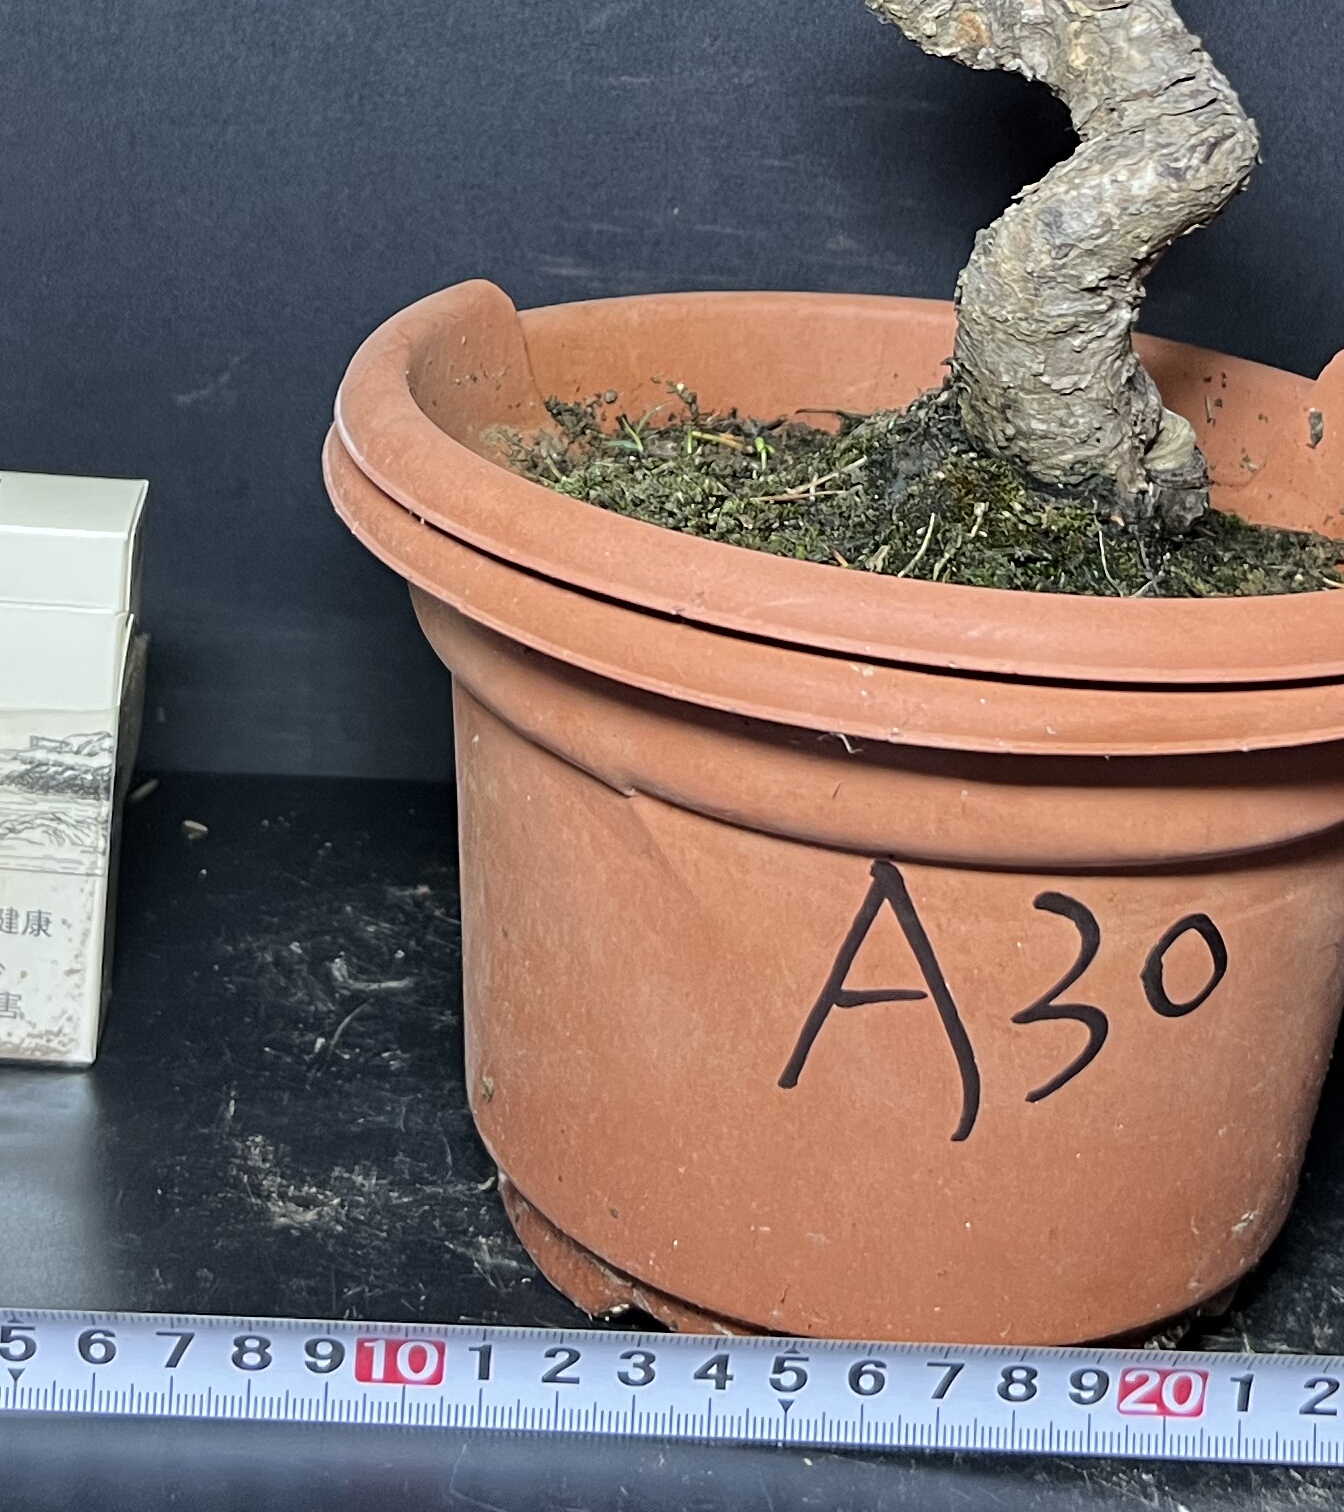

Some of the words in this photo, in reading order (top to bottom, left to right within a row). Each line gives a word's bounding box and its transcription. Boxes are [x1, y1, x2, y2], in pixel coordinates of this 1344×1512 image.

[777, 858, 1229, 1143] A30
[78, 1329, 116, 1365] 6
[155, 1331, 195, 1368] 7
[231, 1335, 272, 1371] 8
[304, 1338, 346, 1374] 9
[361, 1340, 438, 1382] 10
[468, 1344, 493, 1381] 1
[541, 1347, 581, 1385] 2
[617, 1350, 656, 1387] 3
[693, 1353, 734, 1391] 4
[769, 1356, 810, 1393] 5
[848, 1359, 887, 1396] 6
[926, 1361, 965, 1400] 7
[997, 1365, 1038, 1402] 8
[1069, 1368, 1110, 1406] 9
[1119, 1370, 1204, 1413] 20
[1230, 1374, 1254, 1412] 1
[1299, 1377, 1341, 1417] 2
